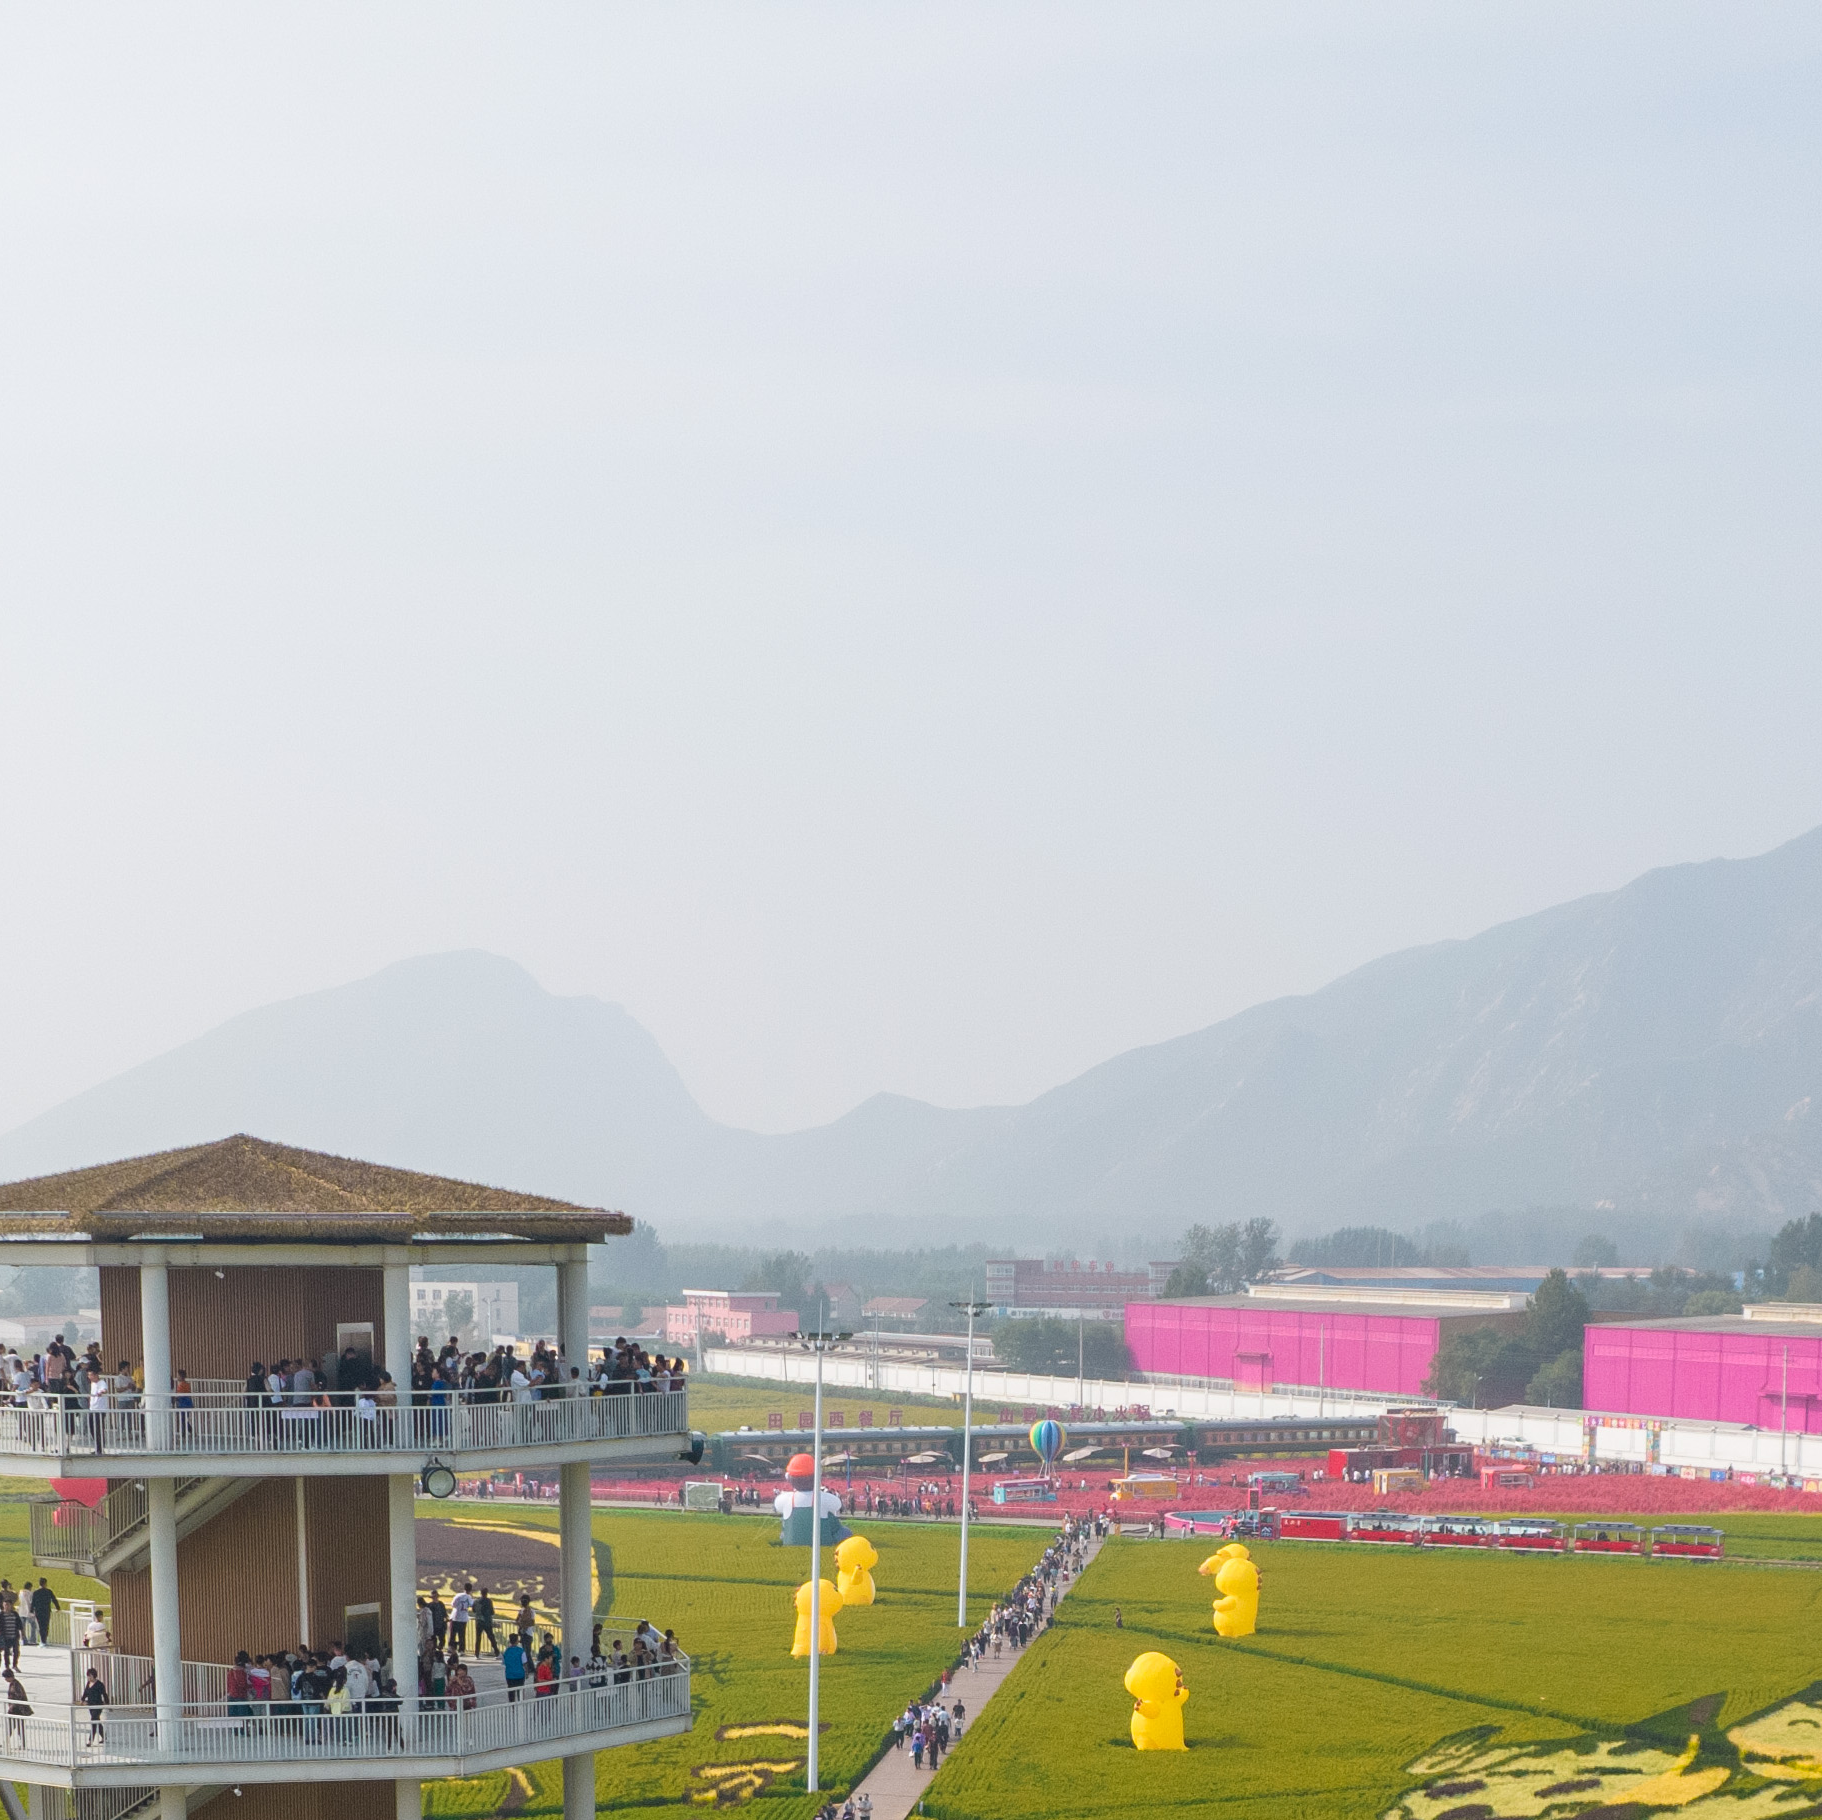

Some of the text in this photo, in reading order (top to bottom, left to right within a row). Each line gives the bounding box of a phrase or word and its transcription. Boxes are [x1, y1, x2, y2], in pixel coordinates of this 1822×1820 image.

[768, 1409, 903, 1429] 田园西餐厅
